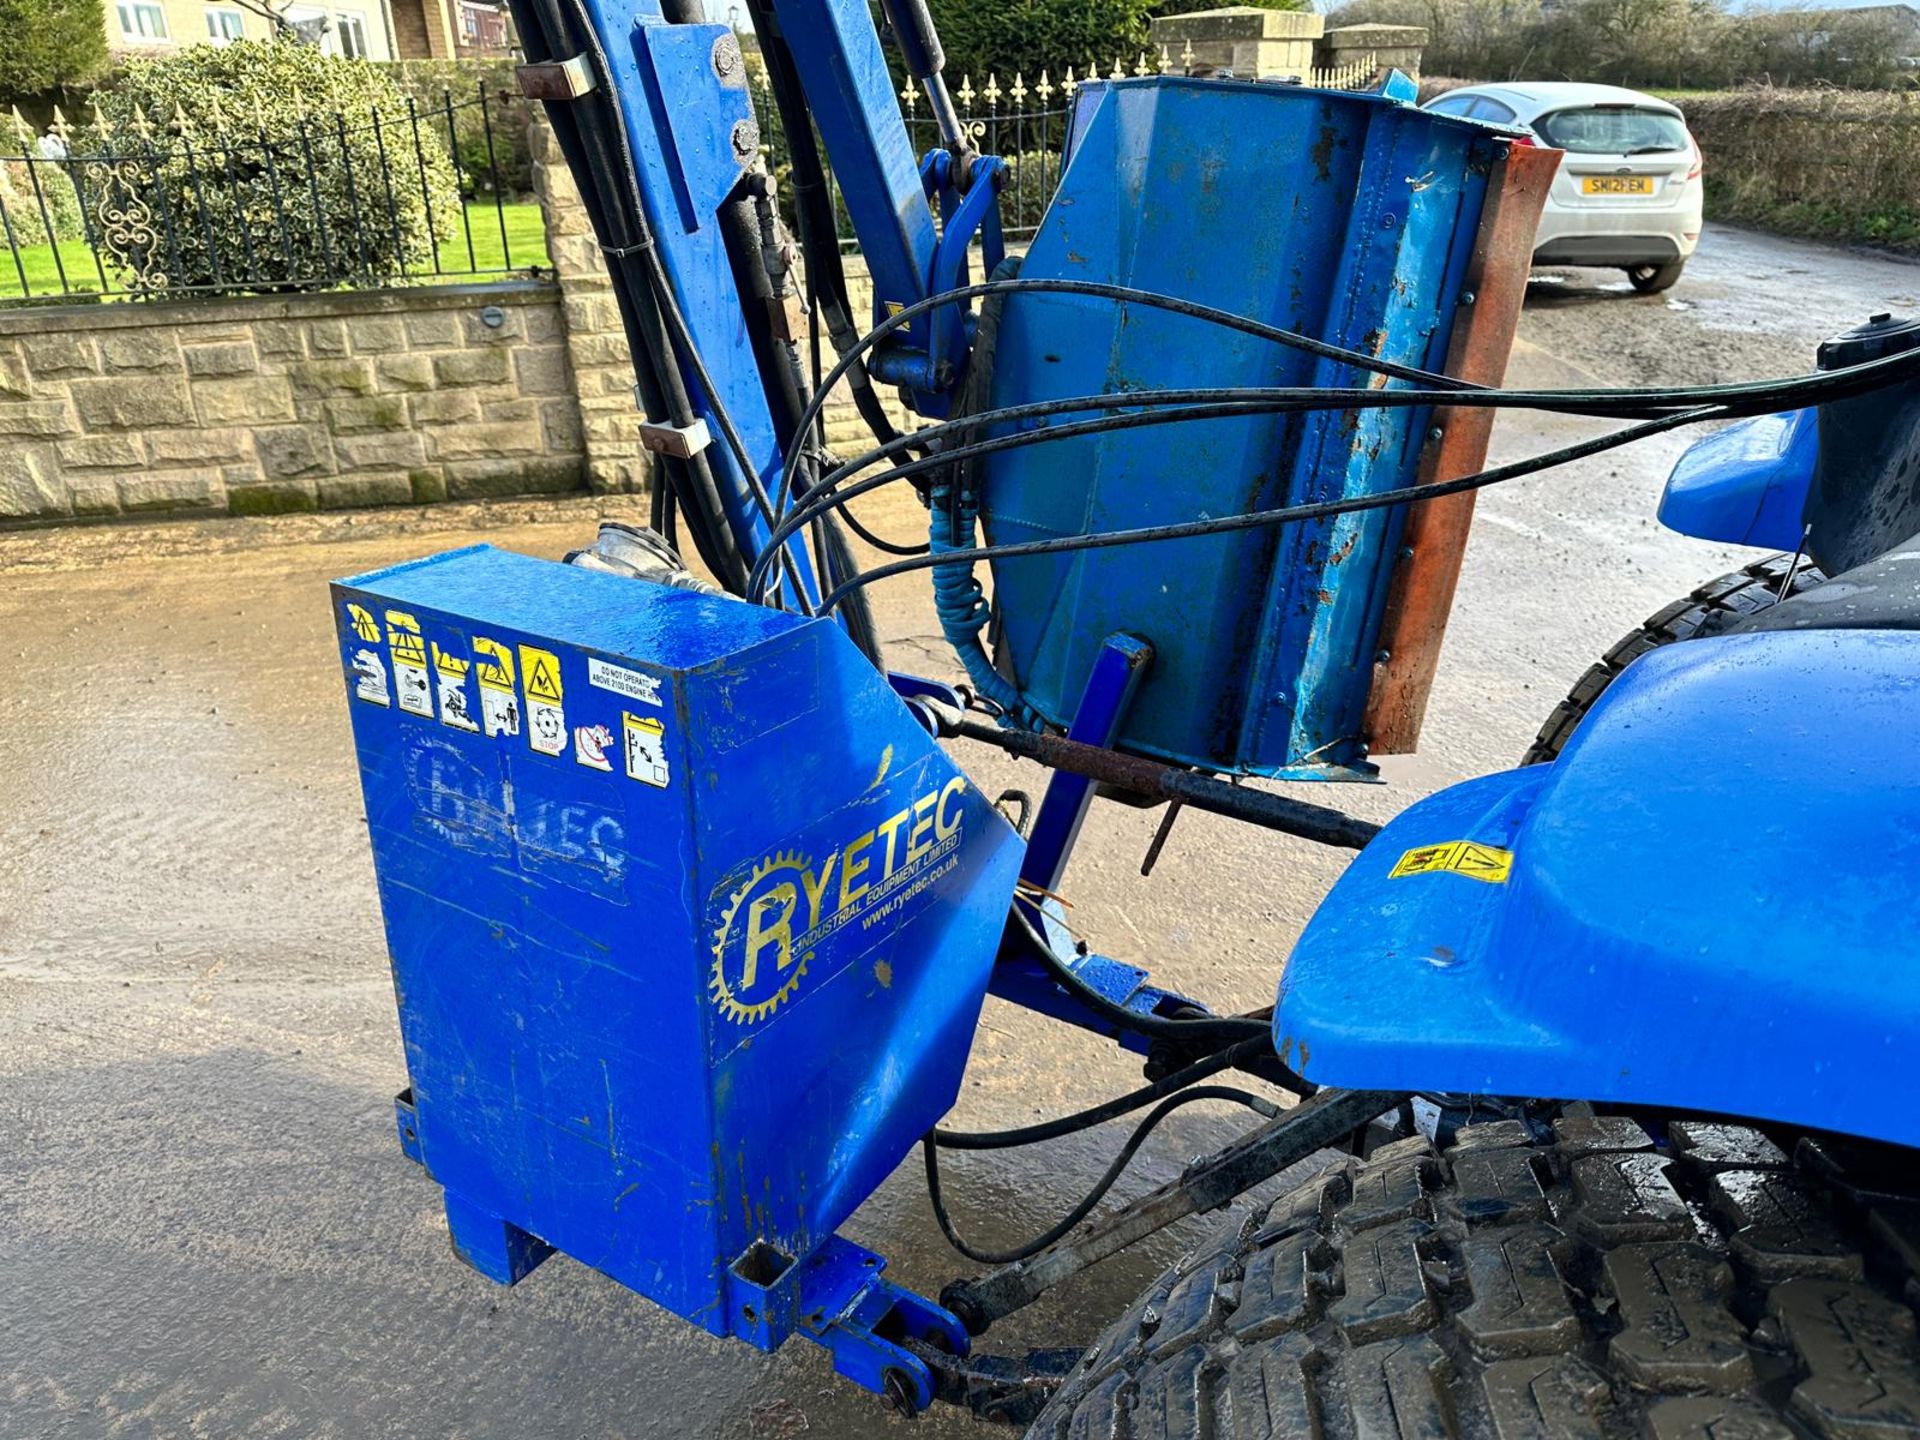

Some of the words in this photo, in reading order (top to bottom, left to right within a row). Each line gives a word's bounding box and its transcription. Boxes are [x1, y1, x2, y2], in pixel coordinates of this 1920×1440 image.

[592, 673, 610, 686] ABOVE
[611, 679, 625, 691] 2100
[625, 684, 646, 698] ENGINE
[601, 666, 610, 676] DO
[610, 669, 623, 680] NOT
[741, 776, 967, 990] RYETEC
[797, 902, 862, 951] INDUSTRIAL
[865, 861, 921, 906] EQUIPMENT
[923, 834, 958, 866] LIMITED
[862, 853, 959, 931] www.ryetec.co.uk
